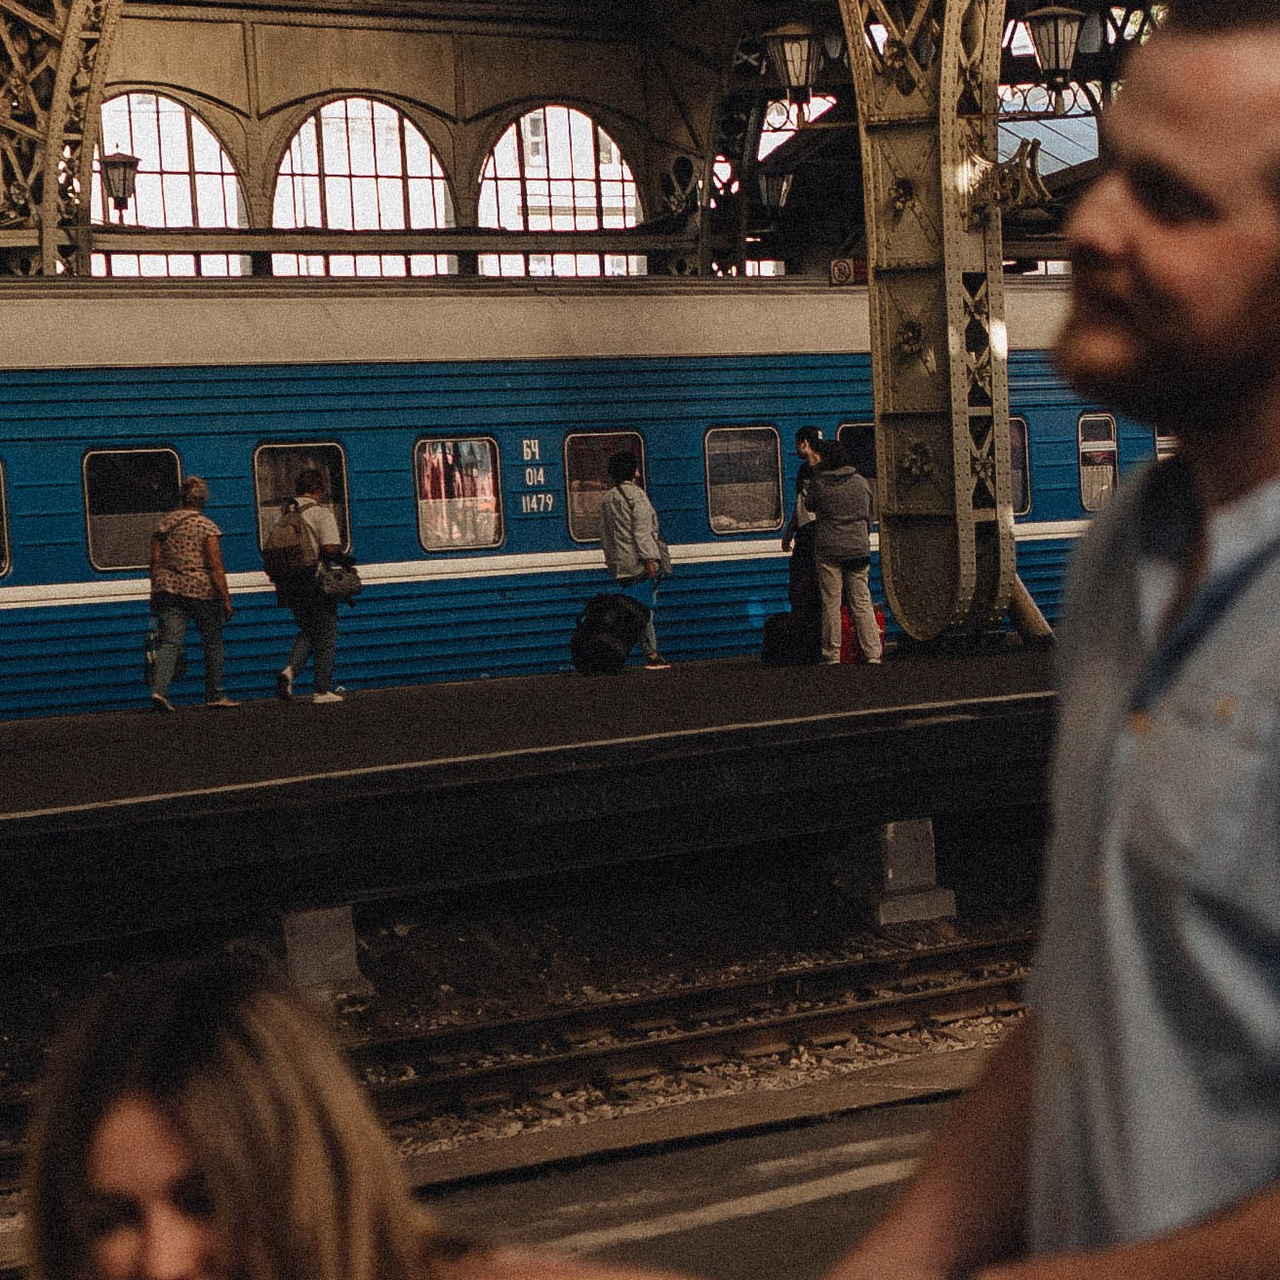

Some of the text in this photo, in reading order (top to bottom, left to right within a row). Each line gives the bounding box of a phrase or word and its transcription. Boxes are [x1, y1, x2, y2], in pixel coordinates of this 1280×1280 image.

[522, 439, 540, 460] БЧ
[525, 467, 545, 485] 014
[522, 494, 553, 513] 11479
